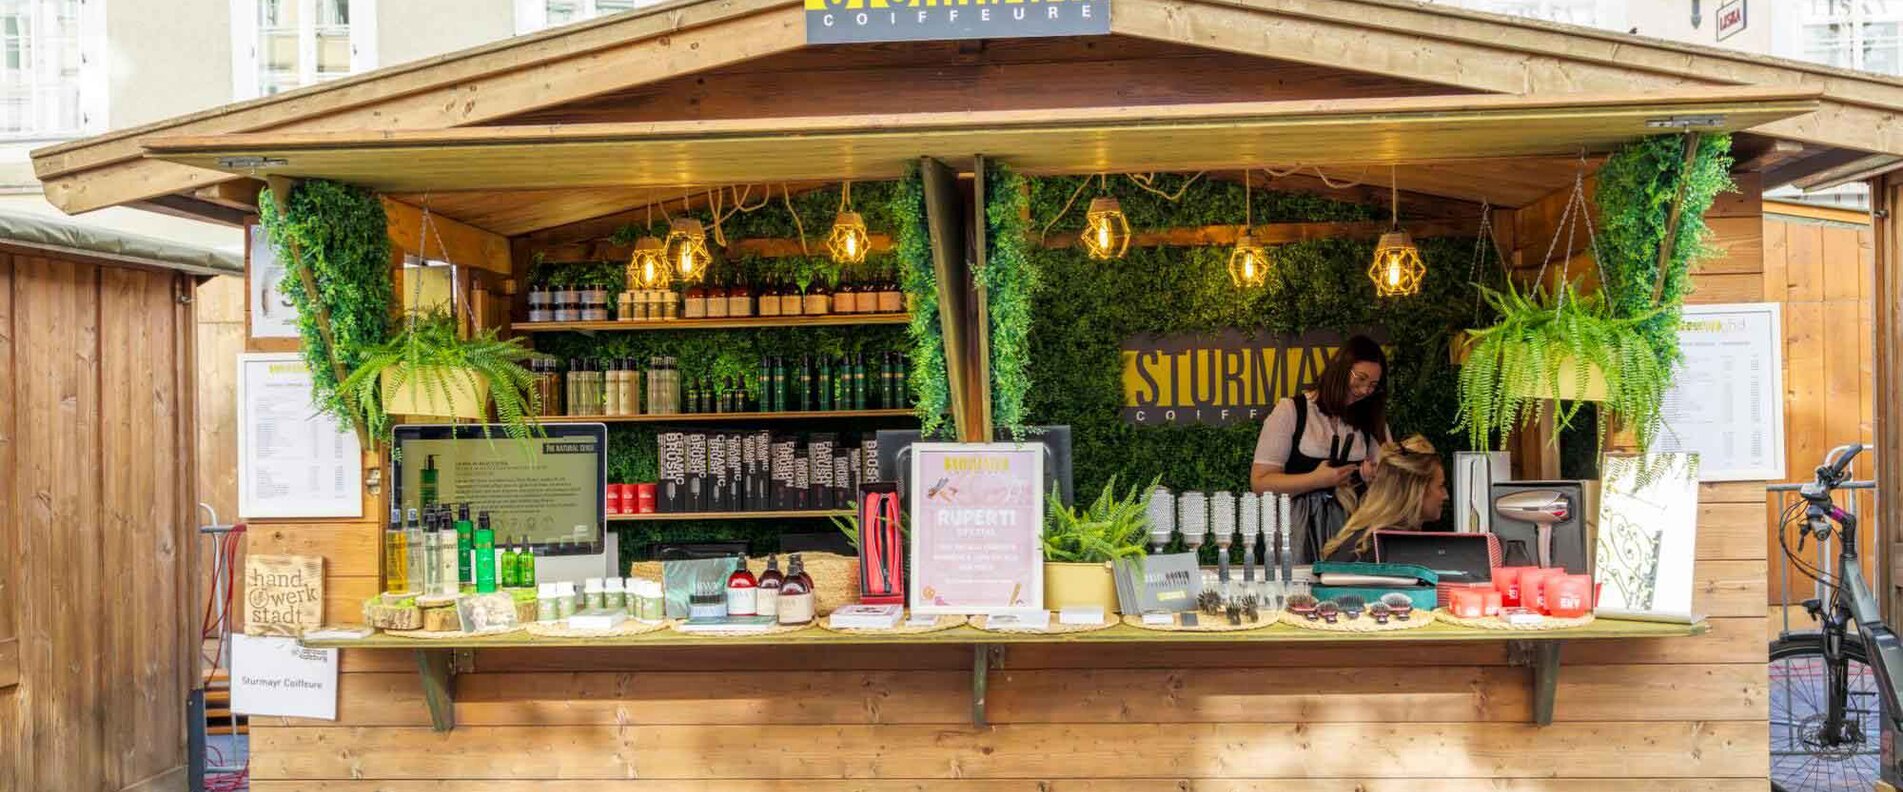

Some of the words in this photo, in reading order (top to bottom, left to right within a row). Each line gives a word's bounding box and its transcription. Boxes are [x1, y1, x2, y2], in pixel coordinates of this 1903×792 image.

[823, 5, 1092, 26] COIFFEURE
[1135, 409, 1258, 422] COIFF
[666, 432, 677, 479] BRUSH
[675, 432, 685, 485] CERAMIC
[690, 434, 701, 473] BRUSH
[716, 434, 726, 487] CERAMIC
[815, 443, 826, 484] BRUSH
[823, 440, 833, 487] FASHION
[937, 508, 1017, 526] RUPERTI
[251, 568, 302, 588] hand
[270, 583, 319, 607] werk
[252, 605, 303, 624] stadt
[241, 677, 281, 690] Sturmayr
[284, 679, 323, 690] Coiffeure
